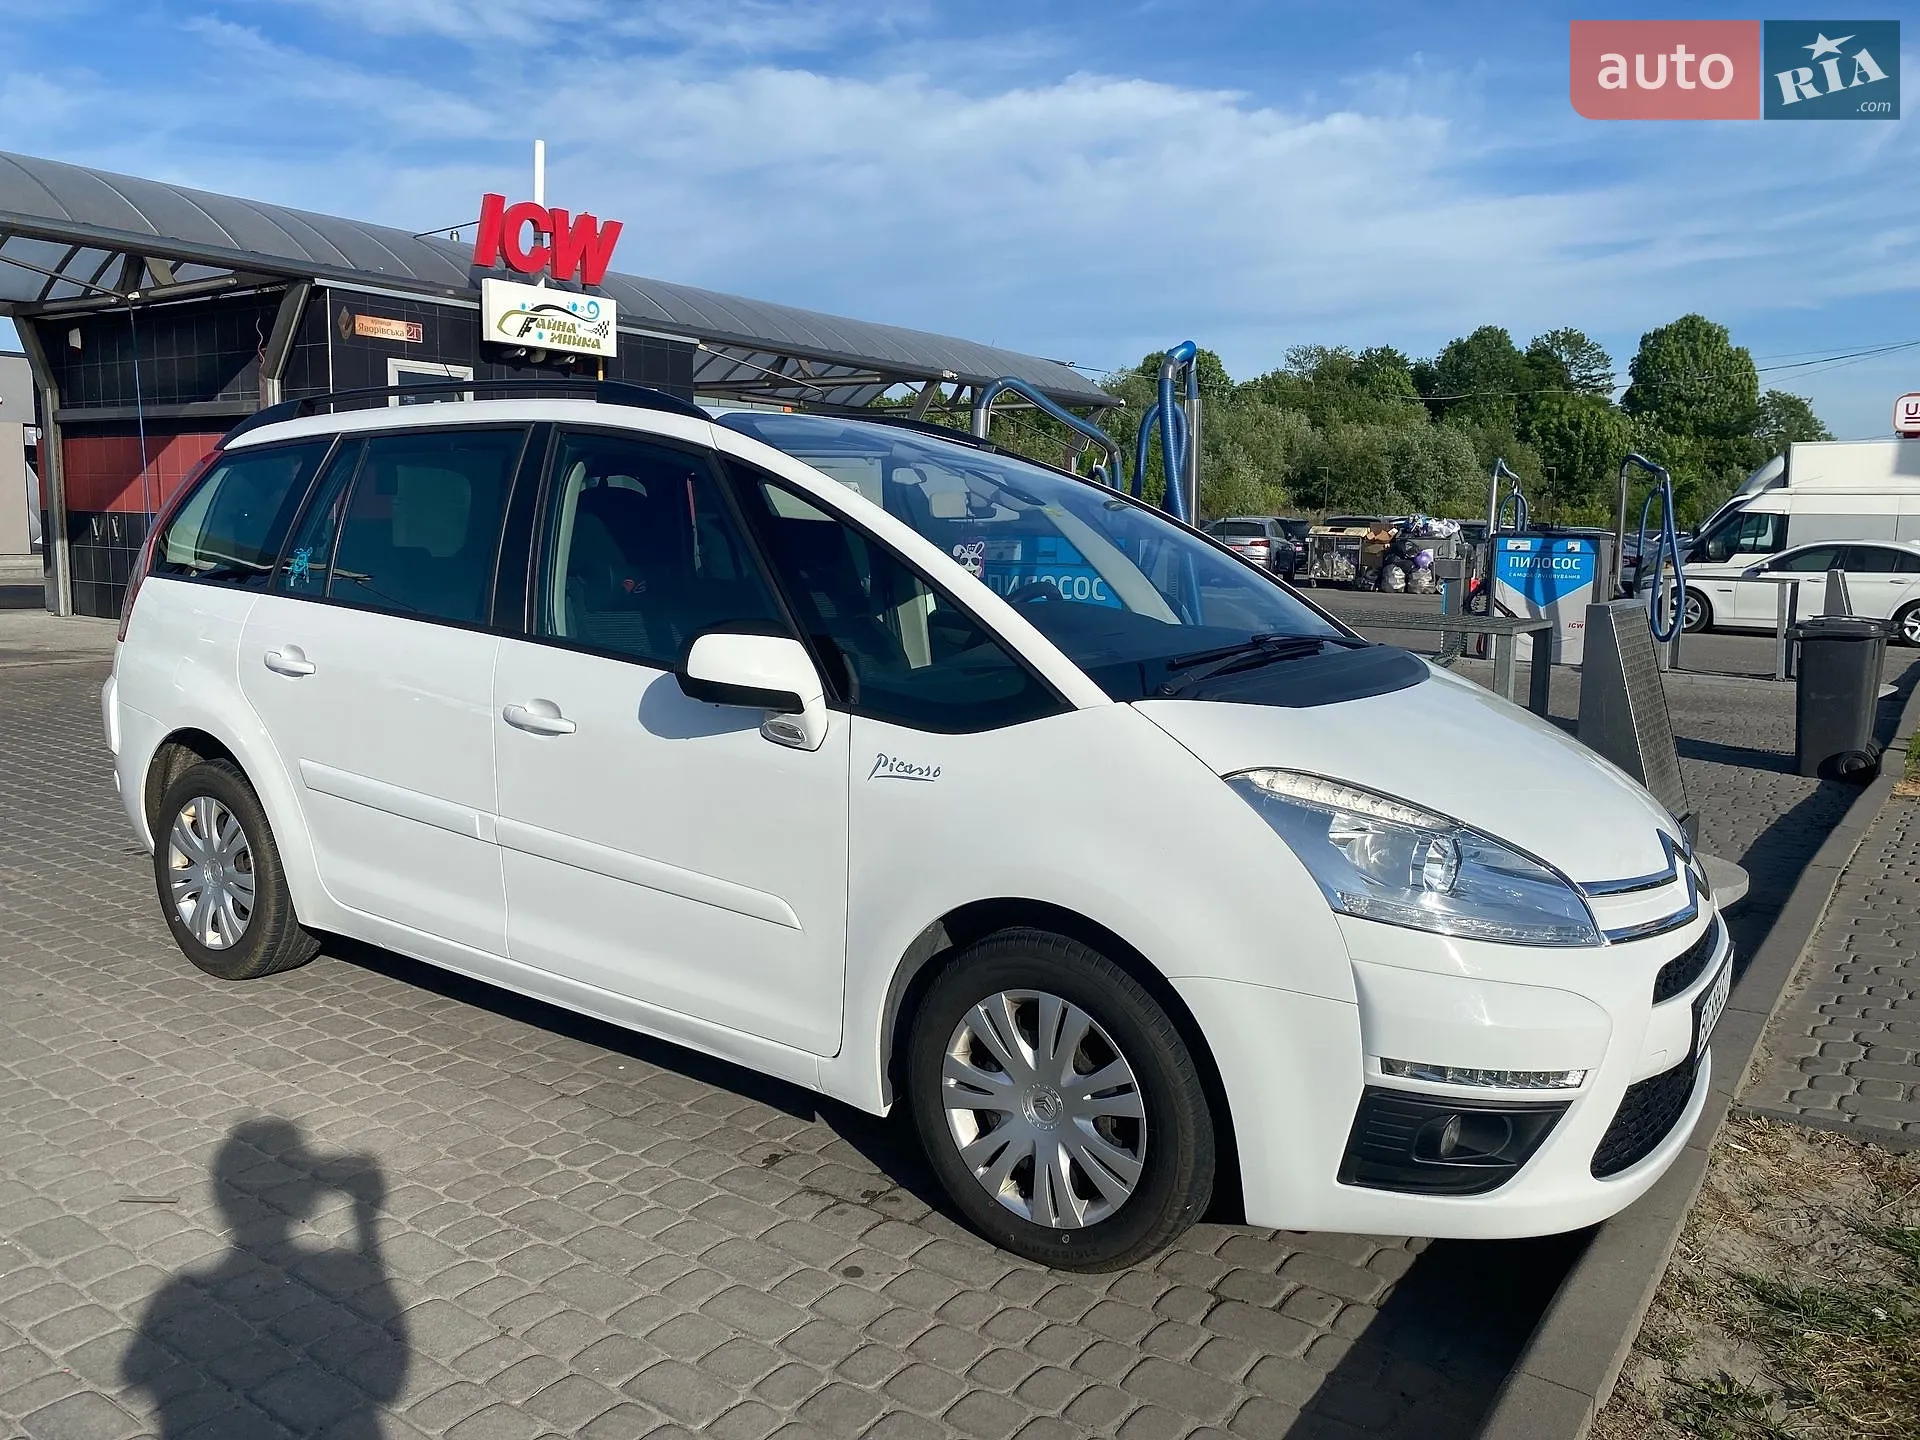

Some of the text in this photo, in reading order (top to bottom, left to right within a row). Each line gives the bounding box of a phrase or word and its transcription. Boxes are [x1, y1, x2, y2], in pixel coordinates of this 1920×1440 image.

[473, 193, 624, 287] ICW
[358, 322, 405, 337] Яворівська
[1509, 556, 1581, 570] ПИЛОСОС
[867, 752, 941, 781] Picasso
